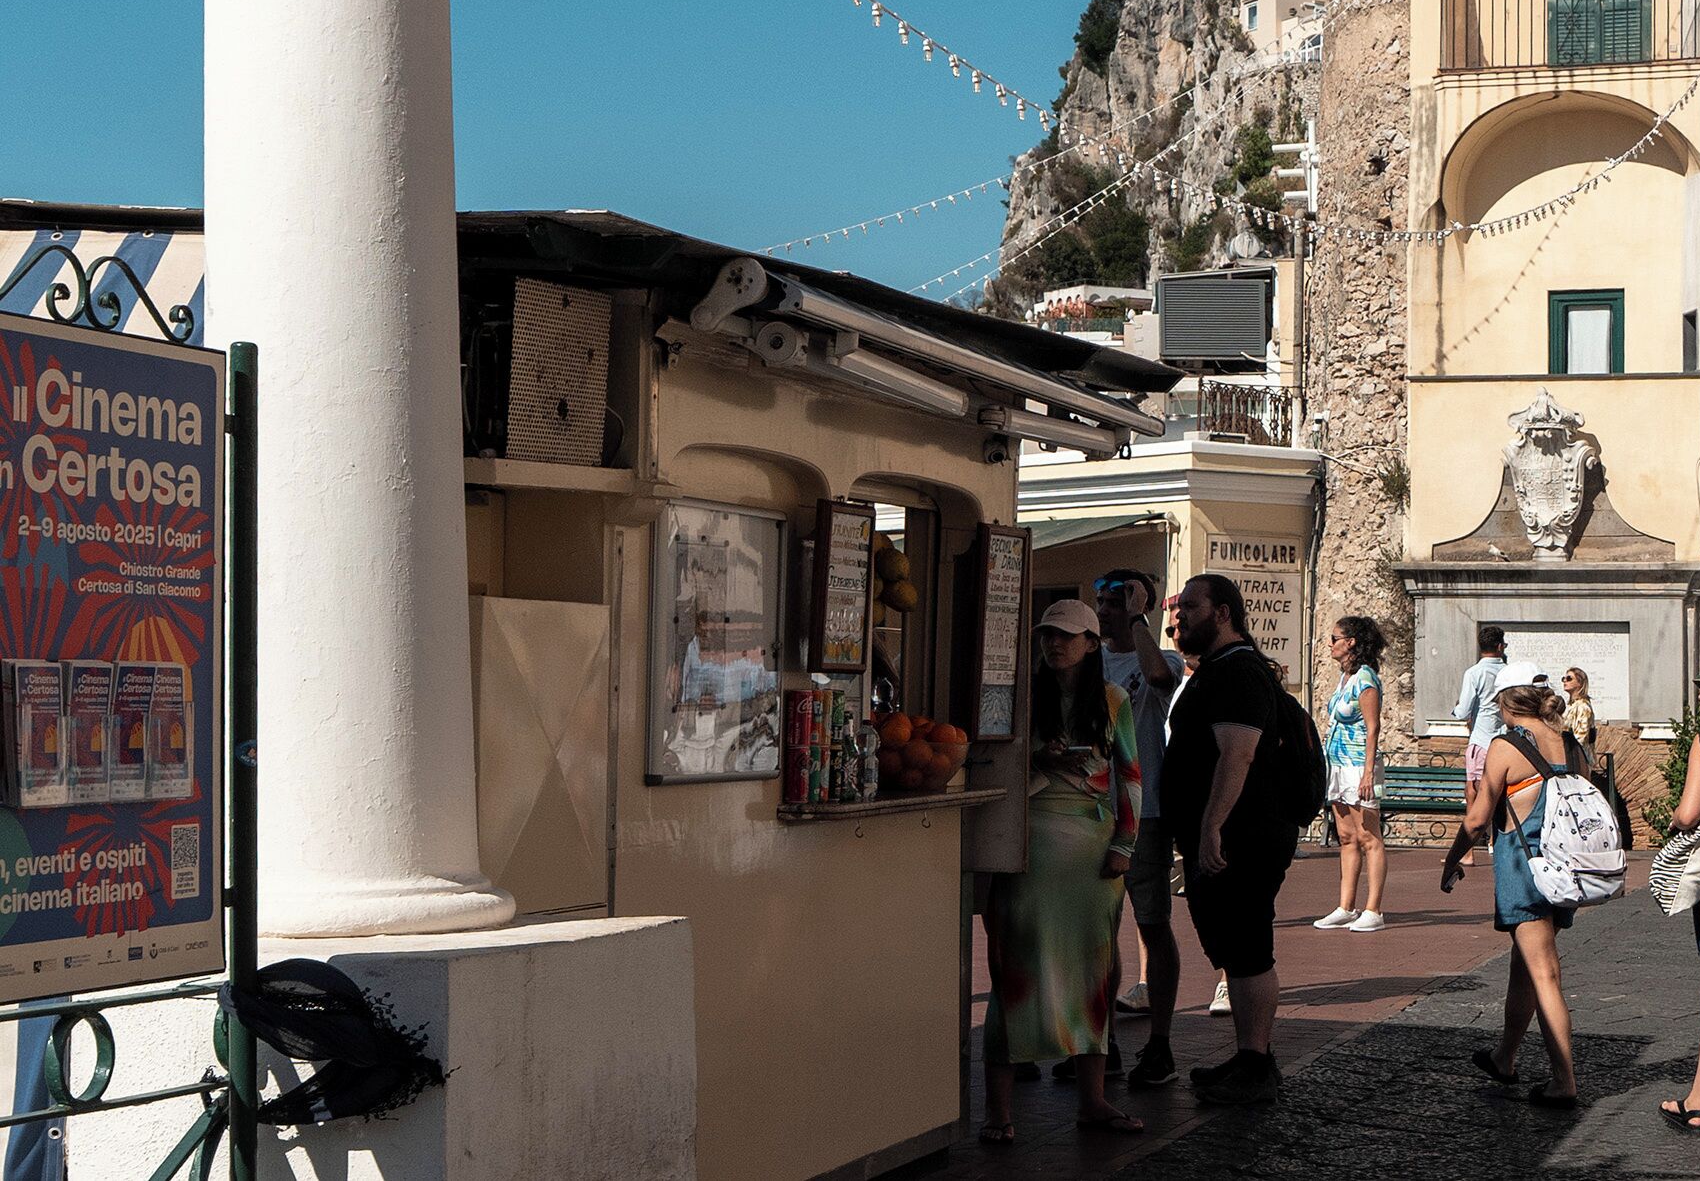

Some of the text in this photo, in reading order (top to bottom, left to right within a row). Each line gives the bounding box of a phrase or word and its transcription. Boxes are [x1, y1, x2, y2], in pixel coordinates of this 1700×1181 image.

[36, 368, 202, 446] Cinema
[0, 434, 202, 508] n Certosa
[57, 521, 111, 544] agosto
[114, 523, 154, 546] 2025
[164, 528, 202, 552] Capri
[1210, 541, 1296, 564] FUNICOLARE
[119, 561, 202, 580] Chiostro Grande
[78, 578, 202, 598] Certosa di San Giacomo
[1234, 579, 1285, 594] NTRATA
[1244, 599, 1292, 613] RANCE
[1263, 618, 1278, 631] IN
[81, 674, 110, 684] Cinema
[126, 674, 152, 683] Cinema
[27, 685, 59, 695] Certosa
[78, 685, 109, 695] Certosa
[122, 683, 152, 694] Certosa
[15, 847, 76, 878] eventi
[79, 852, 92, 872] e
[95, 841, 147, 875] ospiti
[0, 884, 72, 915] cinema
[76, 879, 144, 907] italiano
